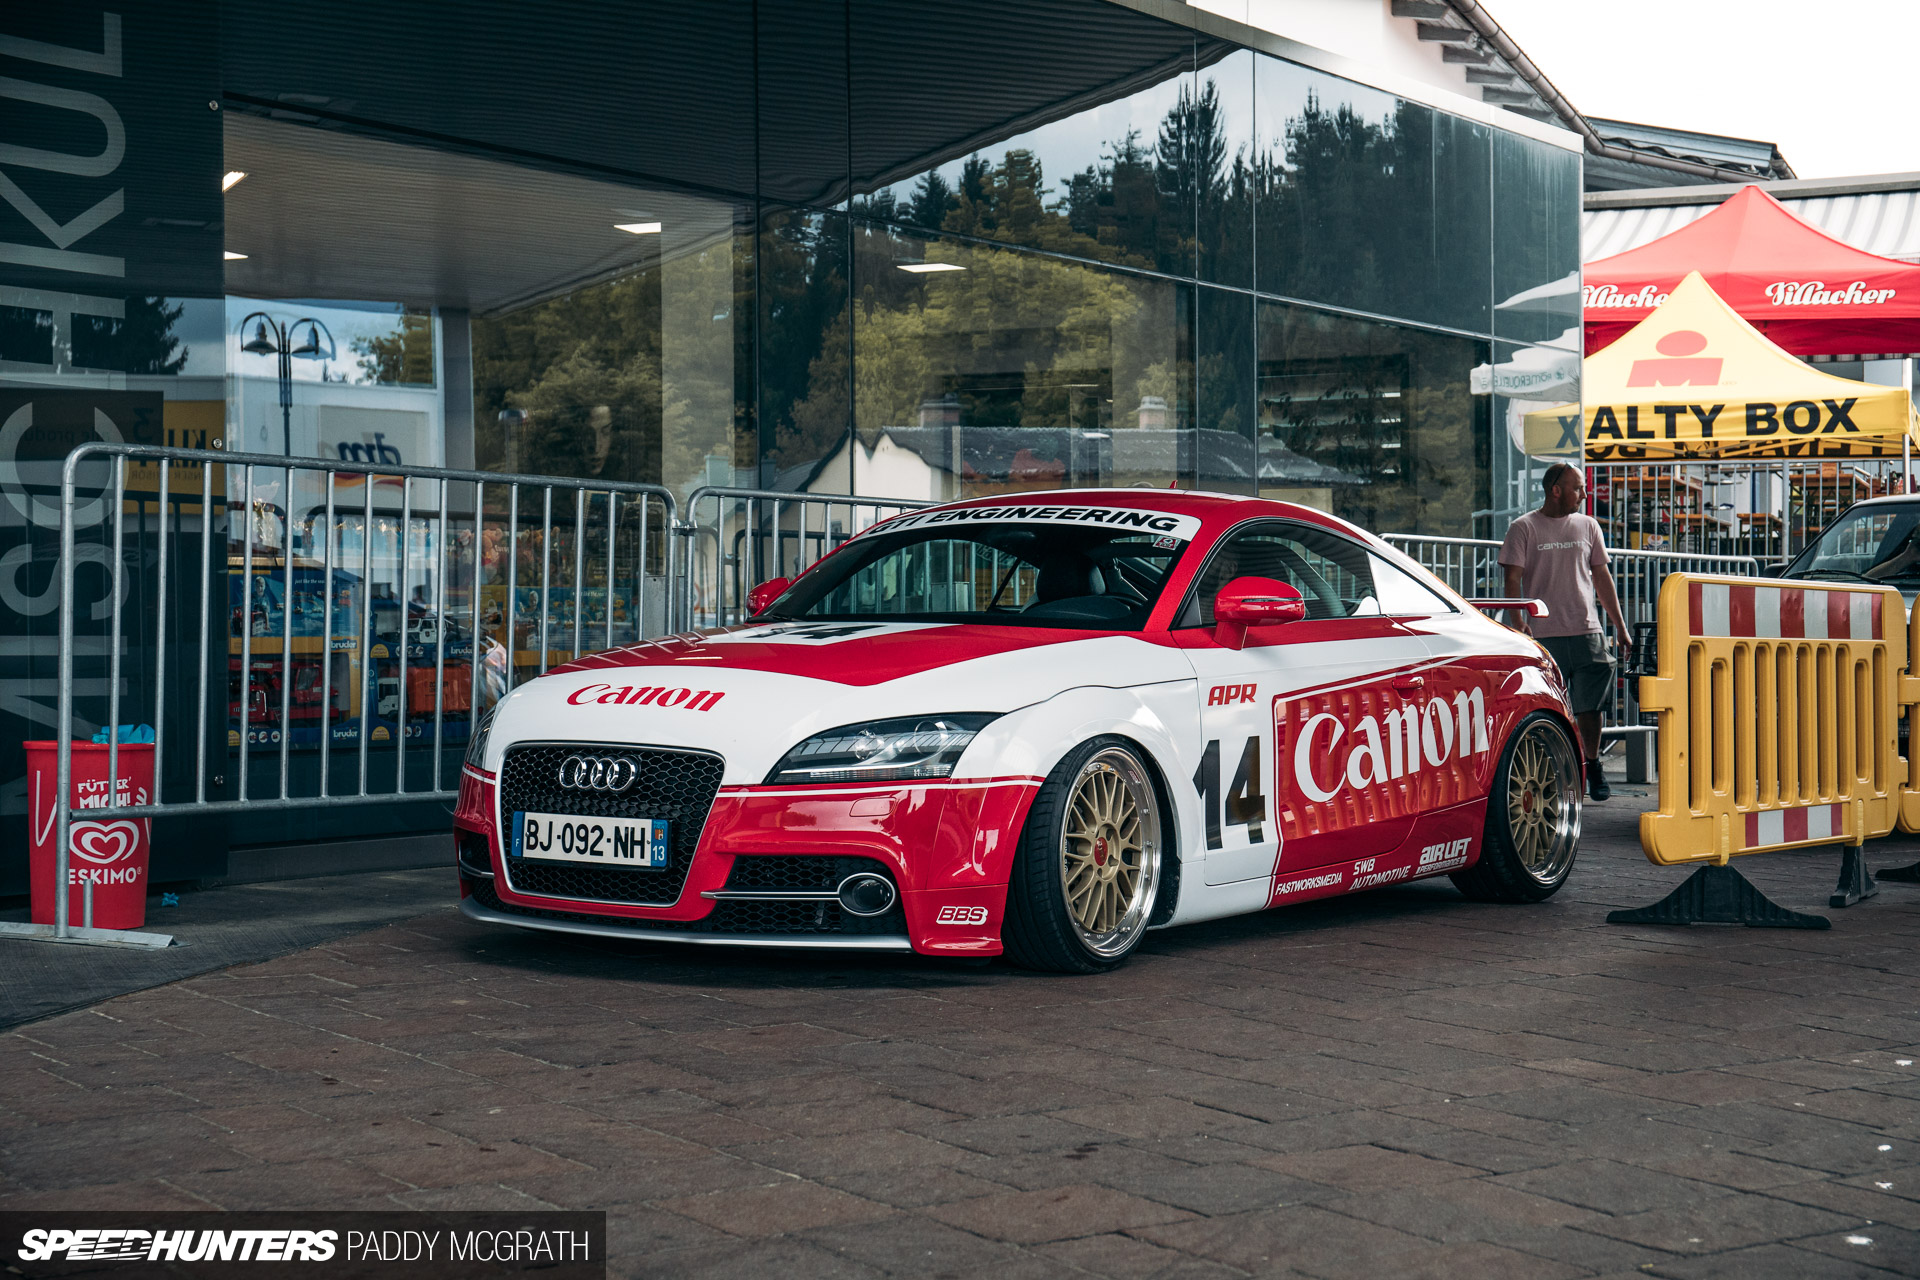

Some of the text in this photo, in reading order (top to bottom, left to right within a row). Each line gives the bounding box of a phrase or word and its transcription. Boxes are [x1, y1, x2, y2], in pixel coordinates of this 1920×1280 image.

[1583, 284, 1669, 309] illache
[1765, 281, 1896, 306] Villacher
[1746, 397, 1860, 436] BOX
[926, 506, 1181, 532] ENGINEERING
[450, 646, 473, 655] brude
[567, 683, 725, 712] Canon
[1208, 683, 1257, 706] APR
[1294, 687, 1490, 803] Canon
[1192, 735, 1266, 850] 14
[653, 845, 665, 861] 13
[1349, 865, 1411, 891] AUTOMOTIVE
[1353, 858, 1375, 875] SWB
[1275, 872, 1342, 896] FASTWORKSMEDIA
[936, 906, 988, 925] BBS
